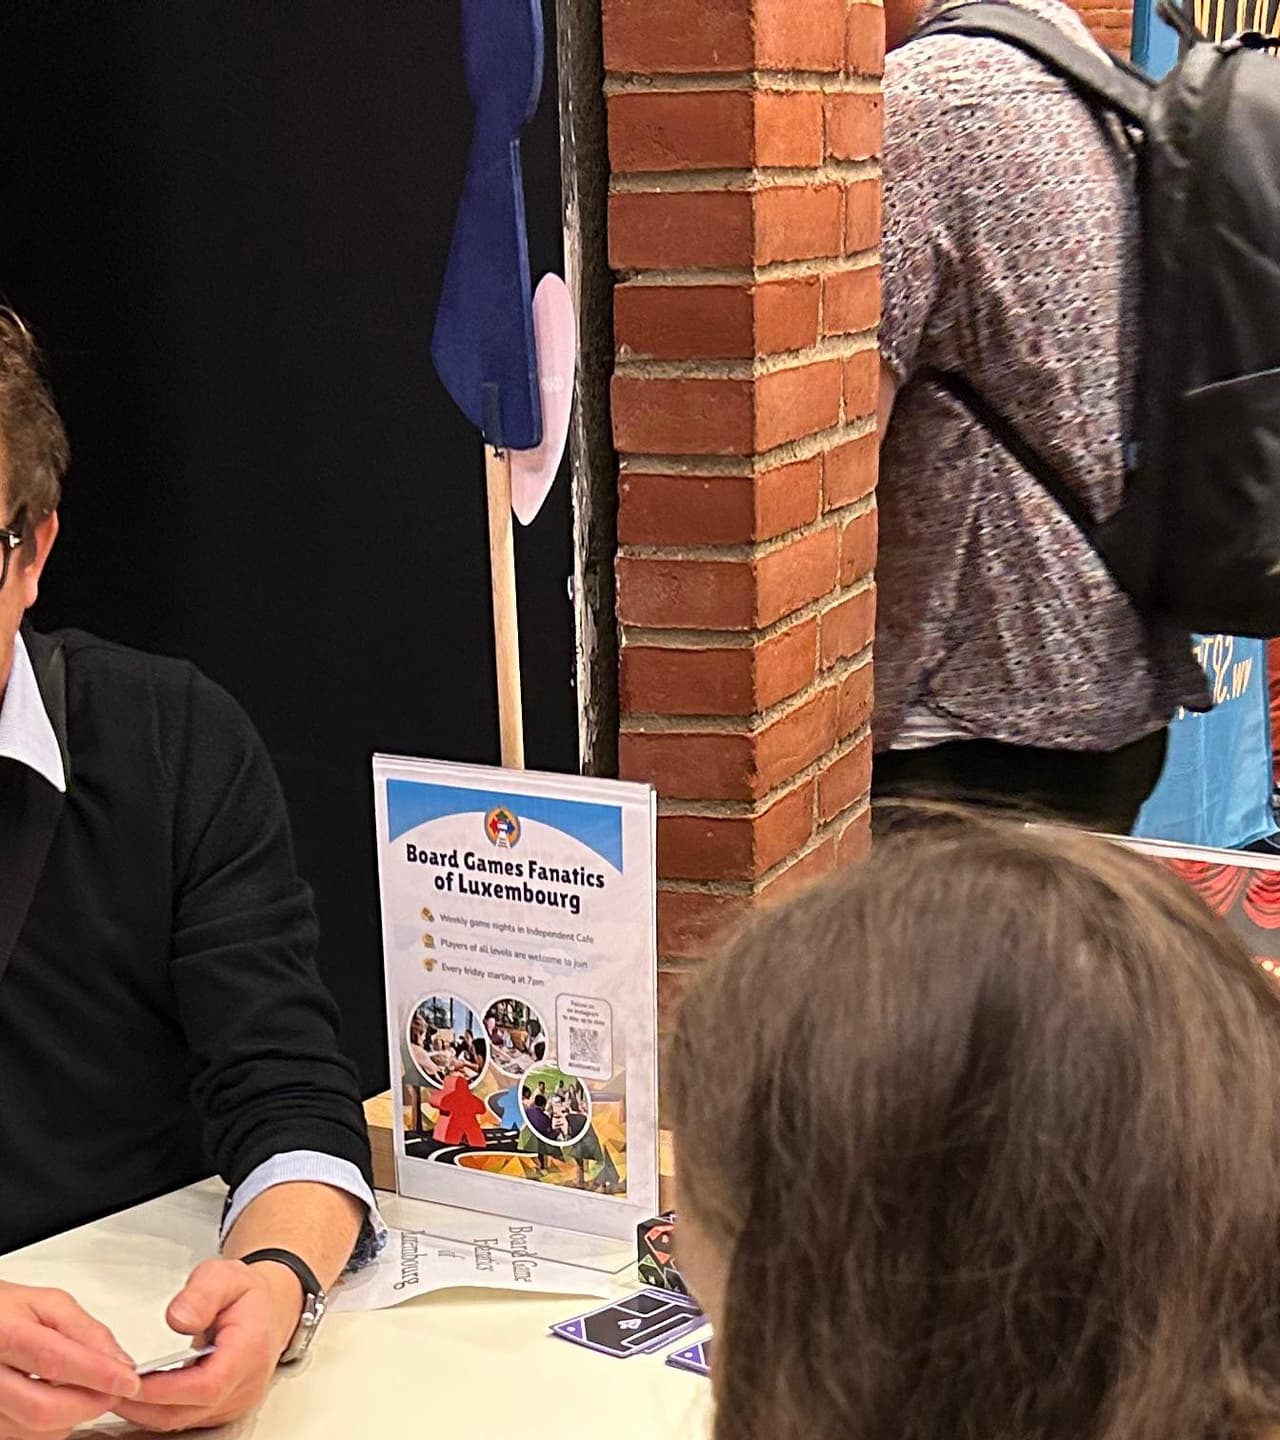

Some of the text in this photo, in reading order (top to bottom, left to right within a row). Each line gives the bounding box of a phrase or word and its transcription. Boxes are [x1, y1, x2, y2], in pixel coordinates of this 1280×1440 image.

[406, 843, 605, 888] Board Games Fanatics
[434, 871, 581, 915] of Luxembourg
[440, 914, 468, 927] Weekly
[470, 918, 491, 929] game
[492, 922, 516, 933] nights
[517, 925, 525, 934] in
[526, 926, 575, 942] Independent
[440, 938, 468, 951] Players
[469, 942, 478, 951] of
[479, 945, 489, 954] all
[490, 946, 512, 957] levels
[514, 951, 526, 960] are
[528, 953, 562, 965] welcome
[564, 957, 572, 966] to
[441, 962, 462, 975] Every
[487, 970, 516, 984] starting
[517, 975, 526, 984] at
[527, 976, 545, 987] 7pm
[508, 1225, 539, 1258] Board
